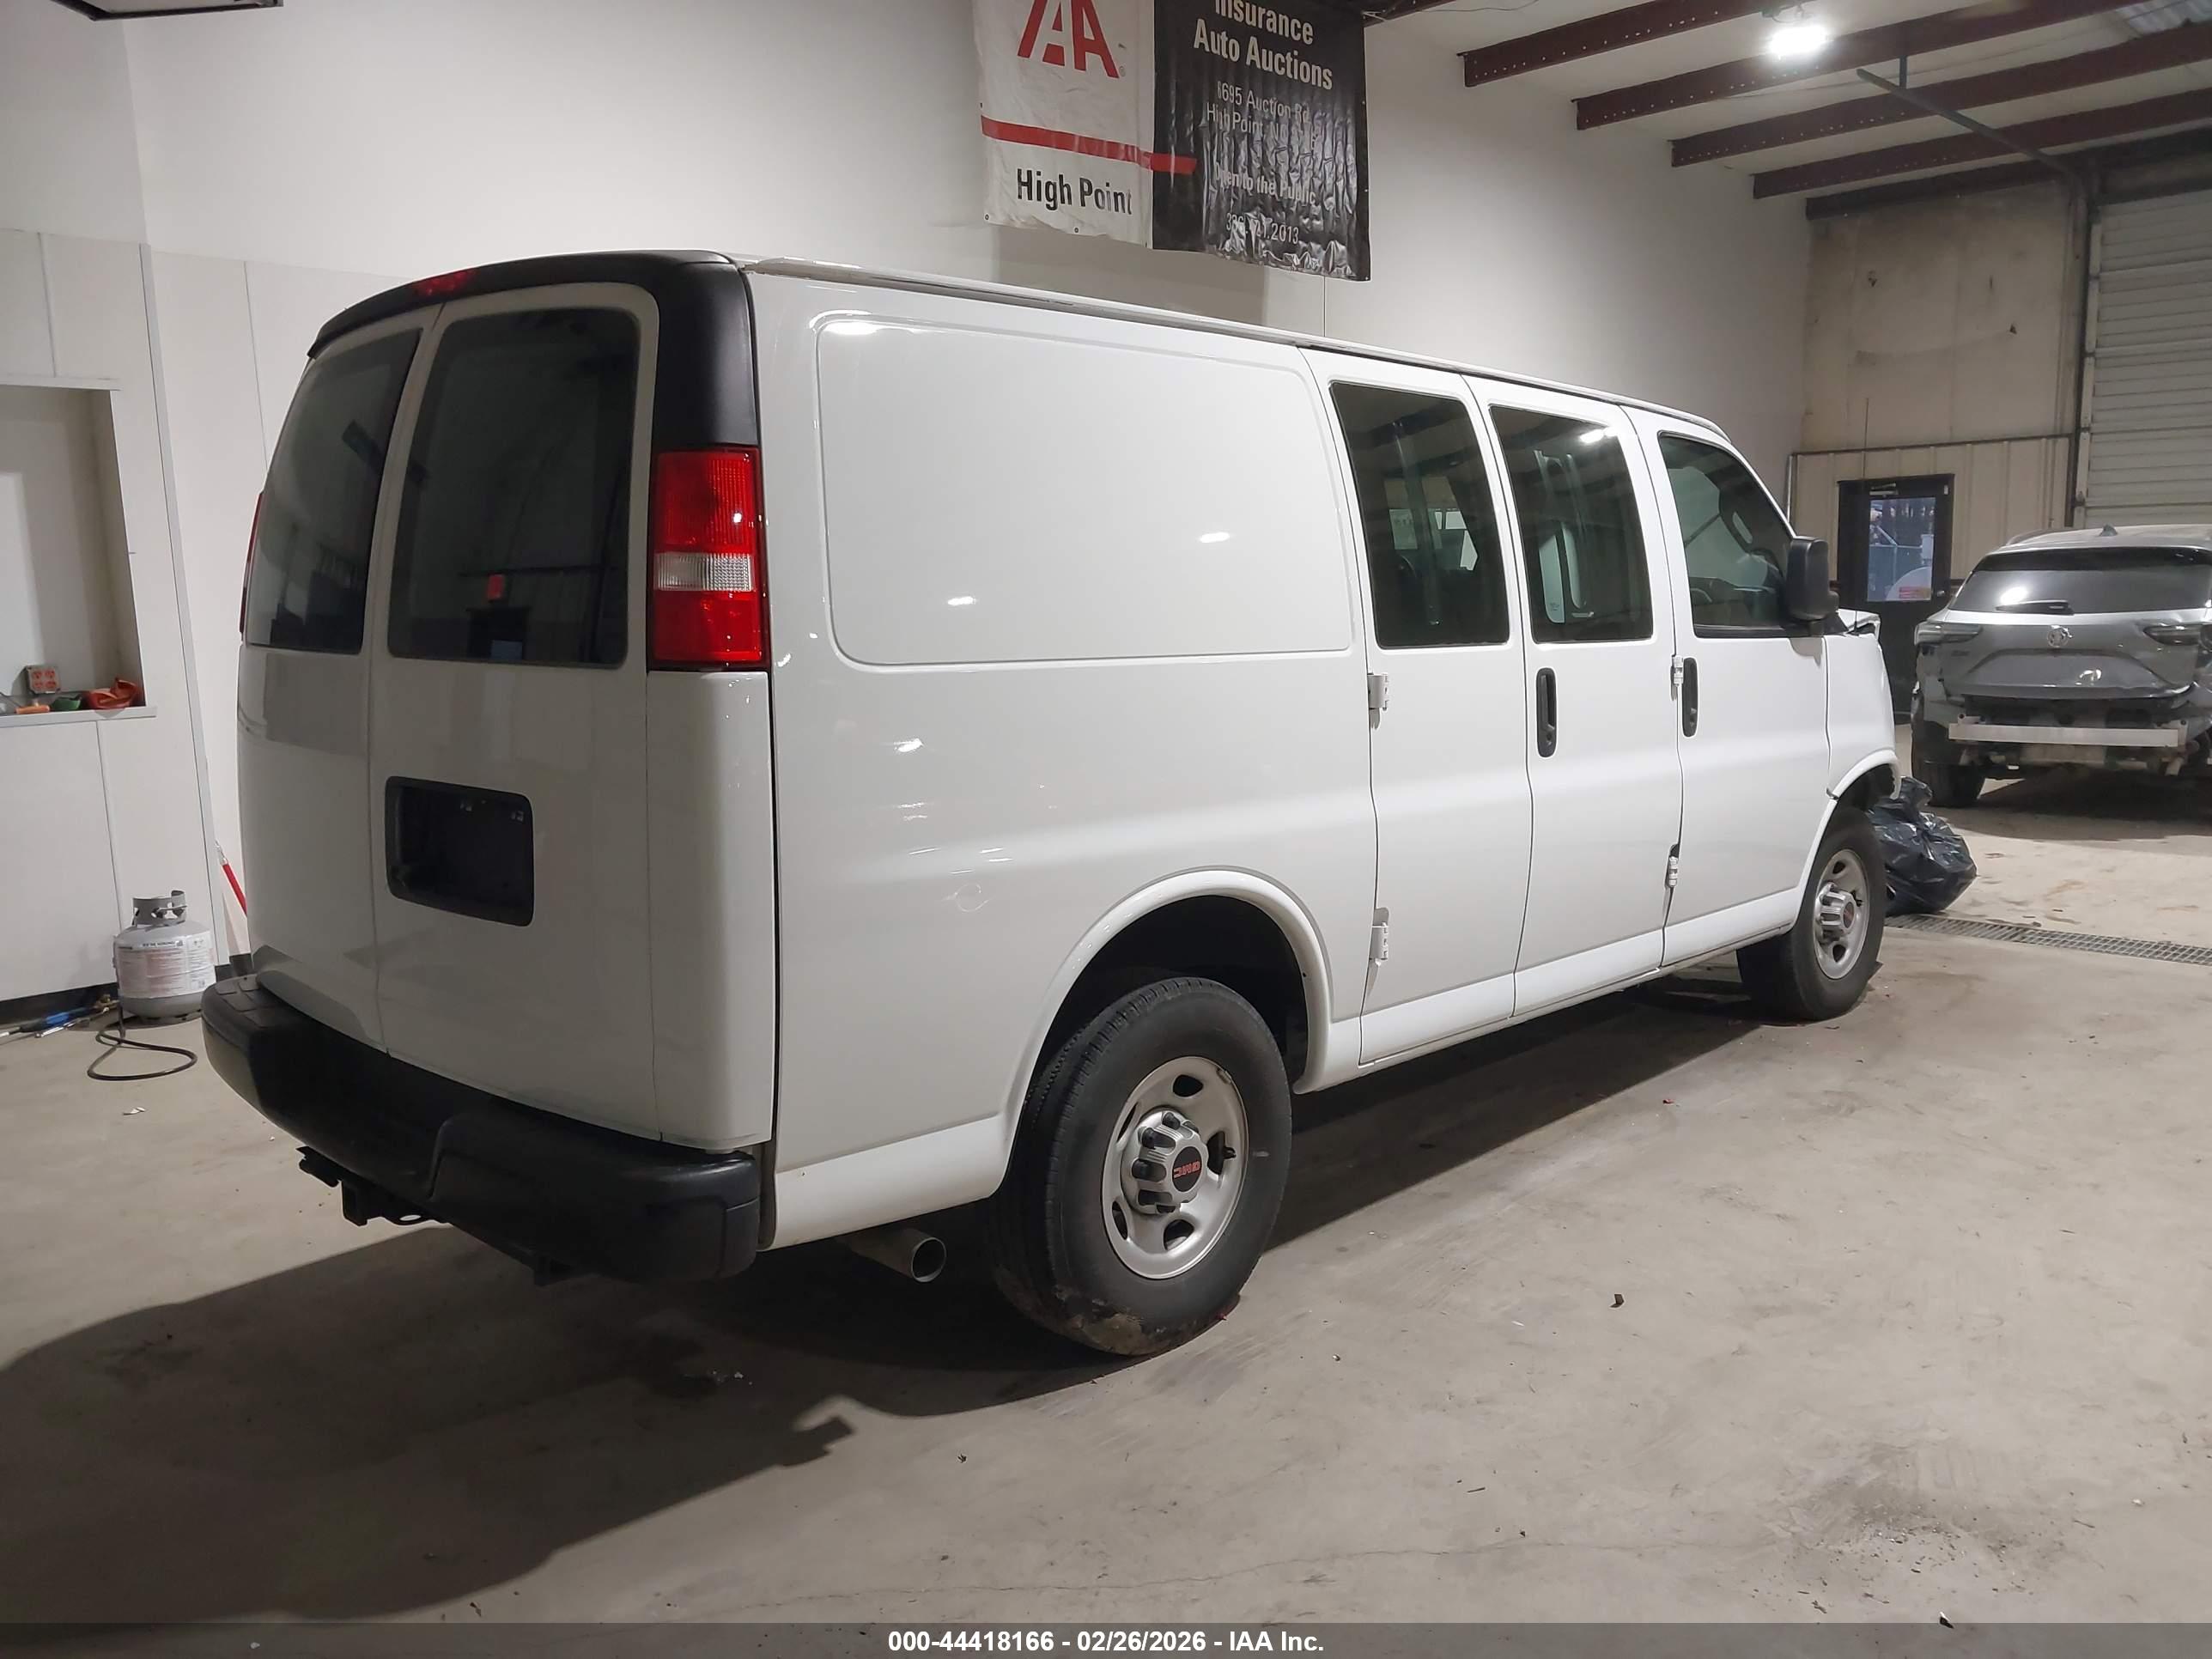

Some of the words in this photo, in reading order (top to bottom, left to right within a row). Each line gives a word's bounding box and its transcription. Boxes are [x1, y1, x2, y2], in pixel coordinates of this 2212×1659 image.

[1193, 18, 1240, 63] Auto
[1245, 36, 1333, 90] Auctions
[1246, 89, 1291, 118] Auction
[1017, 167, 1073, 211] High
[1079, 177, 1133, 215] Point
[1256, 175, 1276, 196] the
